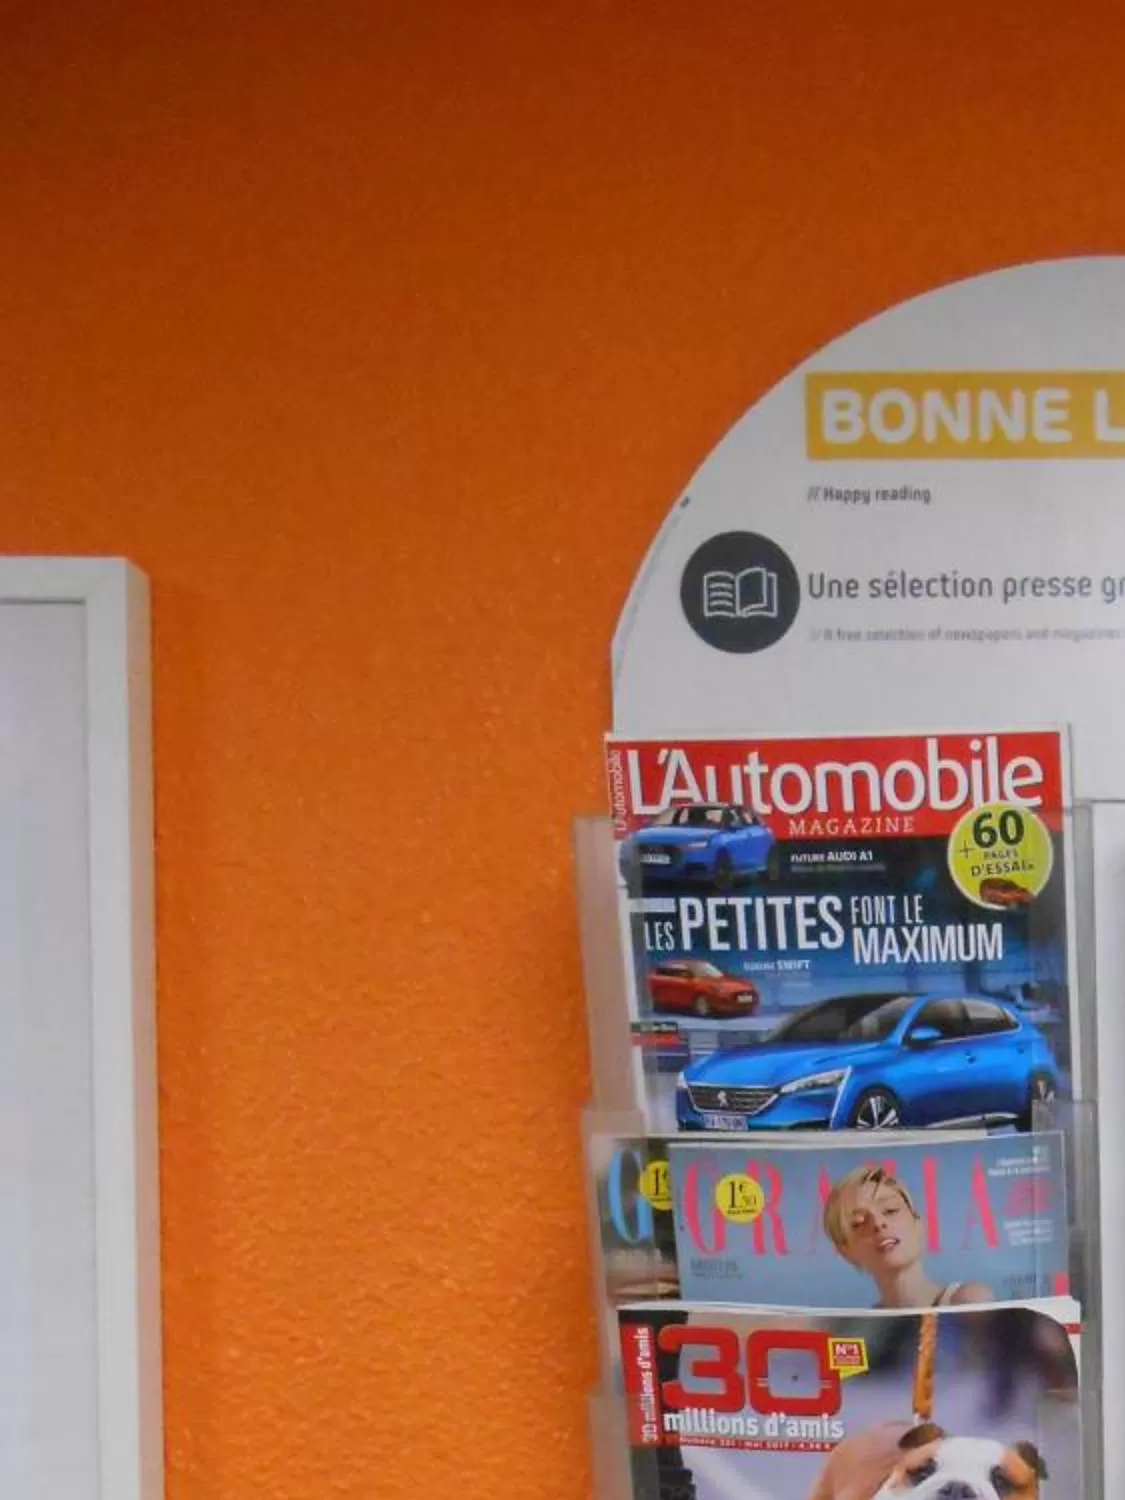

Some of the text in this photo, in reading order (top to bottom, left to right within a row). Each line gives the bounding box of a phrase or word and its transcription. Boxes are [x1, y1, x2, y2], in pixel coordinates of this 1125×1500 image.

[821, 388, 1072, 445] BONNE
[823, 487, 871, 504] Happy
[875, 486, 931, 504] reading
[808, 573, 859, 599] Une
[869, 570, 992, 600] sélection
[1003, 575, 1092, 604] presse
[628, 736, 1043, 816] L'Automobile
[788, 816, 915, 836] MAGAZINE
[973, 809, 1025, 848] 60
[644, 895, 845, 952] LES PETITES
[851, 894, 925, 926] FONT LE
[852, 923, 1004, 966] MAXIMUM
[657, 1325, 843, 1417] 30
[664, 1407, 845, 1440] millions d'amis
